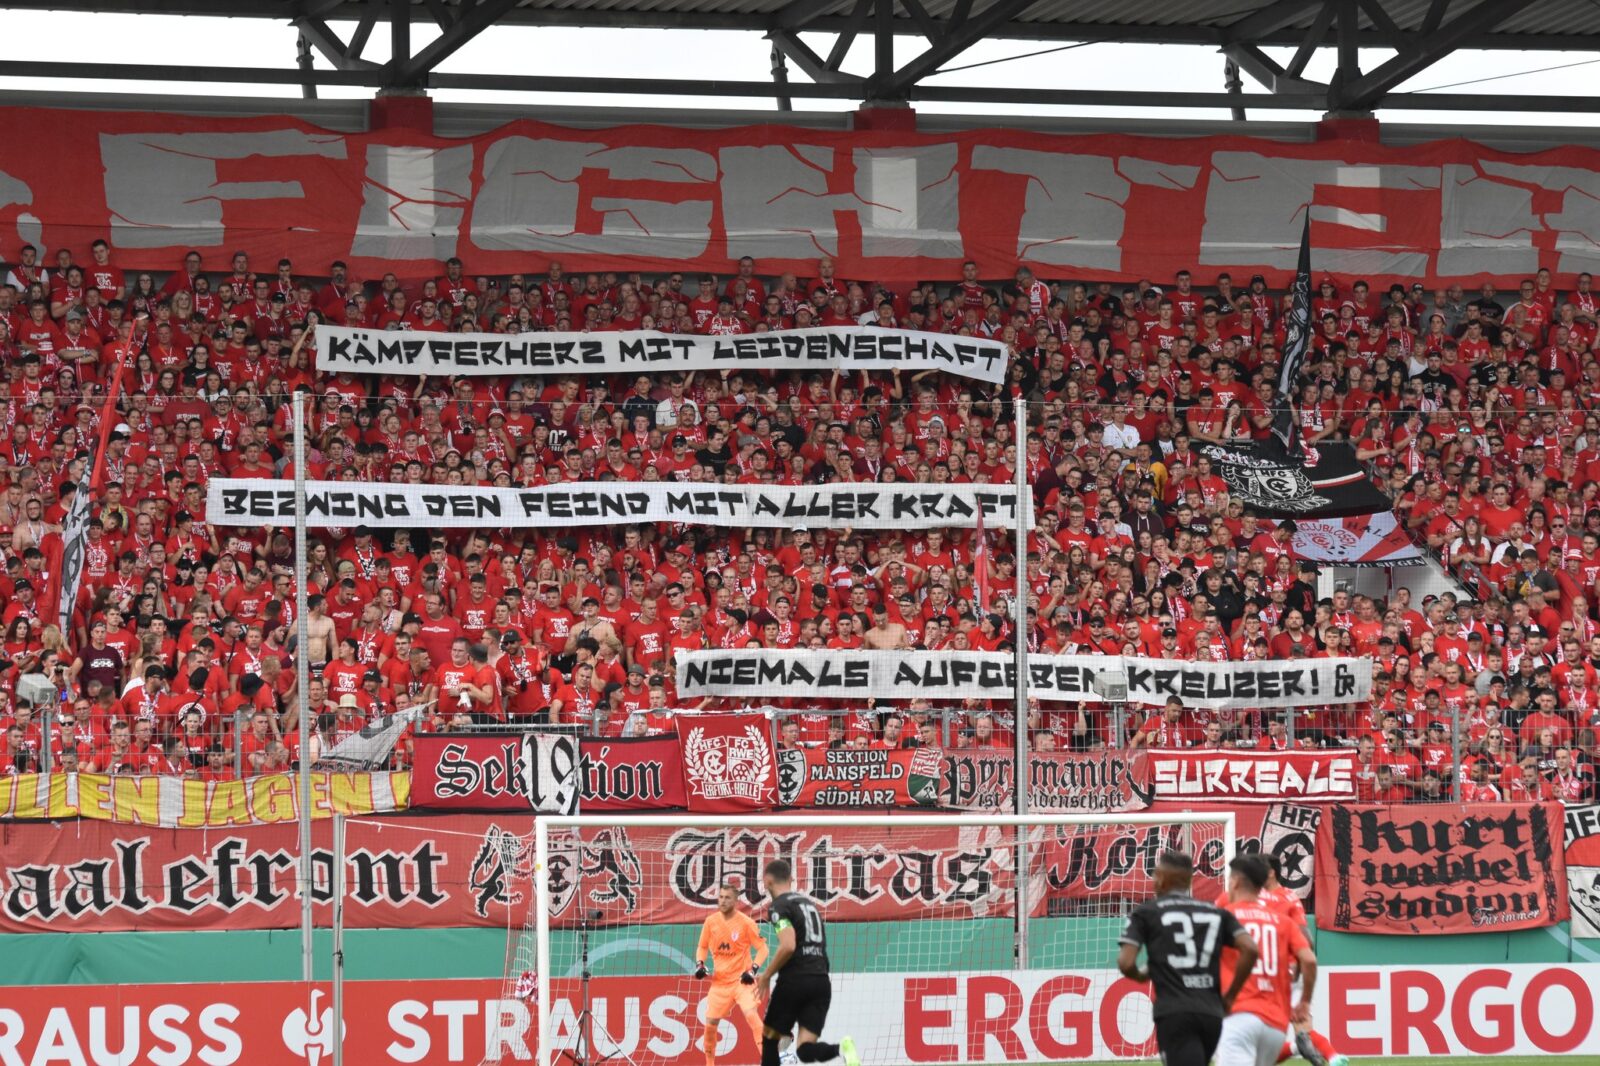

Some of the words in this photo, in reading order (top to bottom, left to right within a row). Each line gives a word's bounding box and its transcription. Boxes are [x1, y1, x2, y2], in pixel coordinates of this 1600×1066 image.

[328, 333, 605, 366] KÄMPFERHERZ
[619, 338, 696, 361] MIT
[713, 334, 1000, 371] LEIDENSCHAFT
[222, 489, 410, 519] BEZWING
[421, 494, 501, 518] DEN
[519, 492, 649, 518] FEIND
[667, 491, 745, 517] MIT
[754, 492, 880, 519] ALLER
[893, 493, 1017, 519] KRAFT
[684, 658, 869, 688] NIEMALS
[894, 660, 1105, 692] AUFGEBEN
[1127, 665, 1319, 699] KREUZER!
[699, 738, 721, 750] HFC
[729, 747, 754, 759] RWE
[734, 738, 749, 749] FC
[826, 750, 888, 764] SEKTION
[810, 763, 904, 781] MANSFELD
[941, 754, 1124, 805] Pyrmanie
[1154, 758, 1353, 795] SURREALE
[177, 771, 374, 828] JAGEN
[814, 786, 896, 806] SÜDHARZ
[1011, 788, 1125, 810] eidenschaft
[1280, 805, 1321, 829] HFC
[1564, 810, 1600, 841] HF
[2, 836, 451, 923] aalefront
[799, 904, 822, 943] 10
[1161, 912, 1221, 969] 37
[386, 996, 738, 1064] STRAUSS
[903, 976, 1160, 1062] ERGO
[1328, 967, 1594, 1055] ERGO
